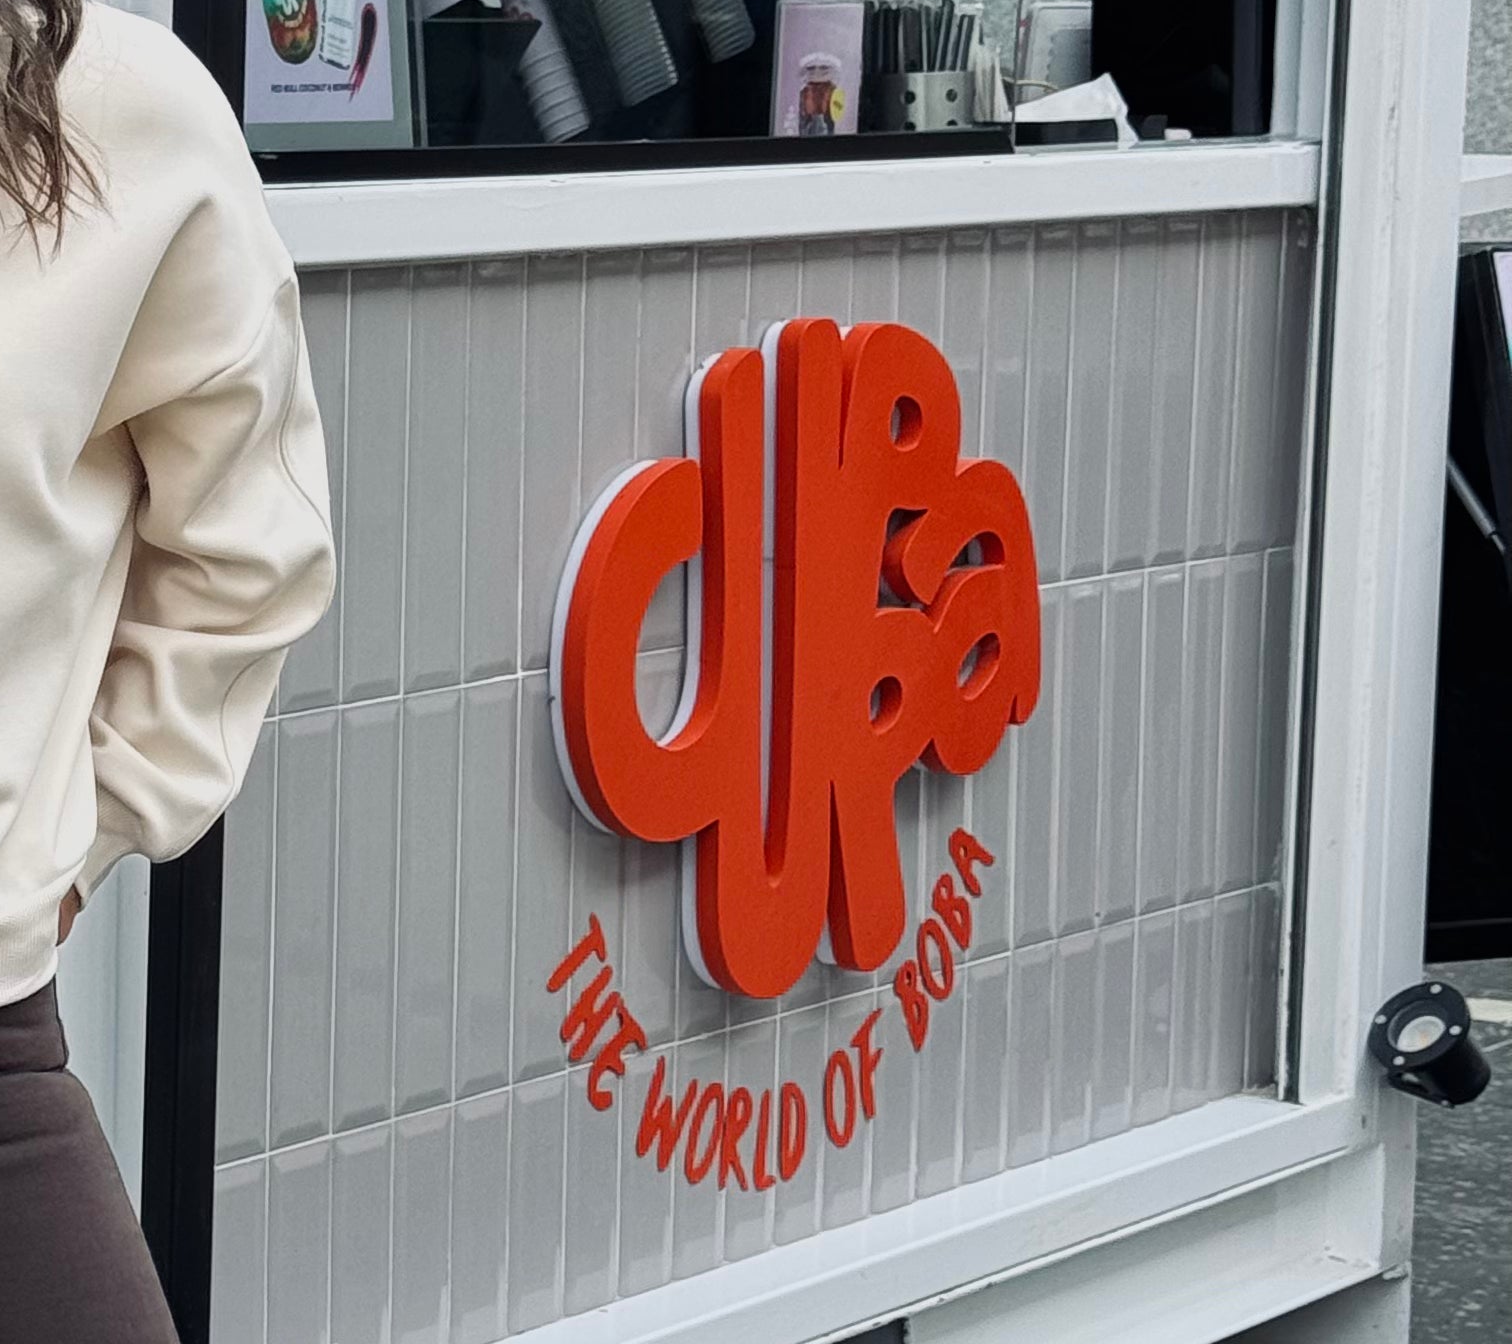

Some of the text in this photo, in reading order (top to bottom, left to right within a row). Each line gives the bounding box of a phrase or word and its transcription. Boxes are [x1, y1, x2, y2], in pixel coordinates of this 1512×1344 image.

[546, 827, 995, 1191] THE WORLD OF BOBA
